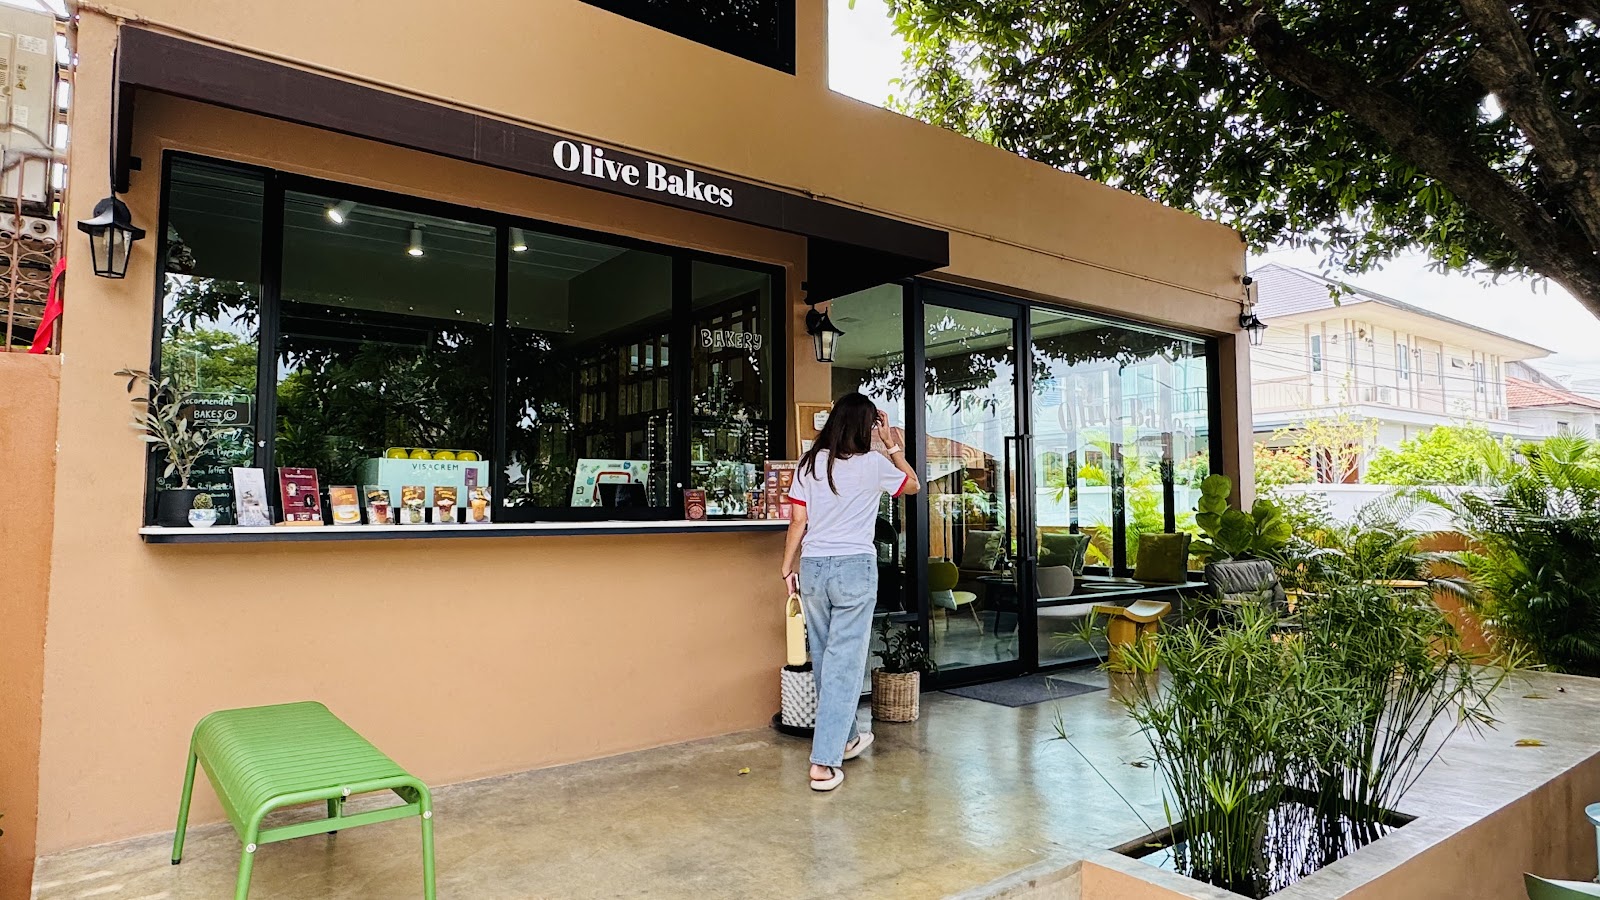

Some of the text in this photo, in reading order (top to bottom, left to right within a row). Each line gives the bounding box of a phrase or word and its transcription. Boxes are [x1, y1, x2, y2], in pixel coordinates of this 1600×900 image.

[552, 140, 734, 208] Olive Bakes
[701, 328, 762, 350] BAKERY
[182, 395, 234, 406] ecommended
[193, 409, 223, 419] BAKES
[412, 463, 459, 471] VISACREM
